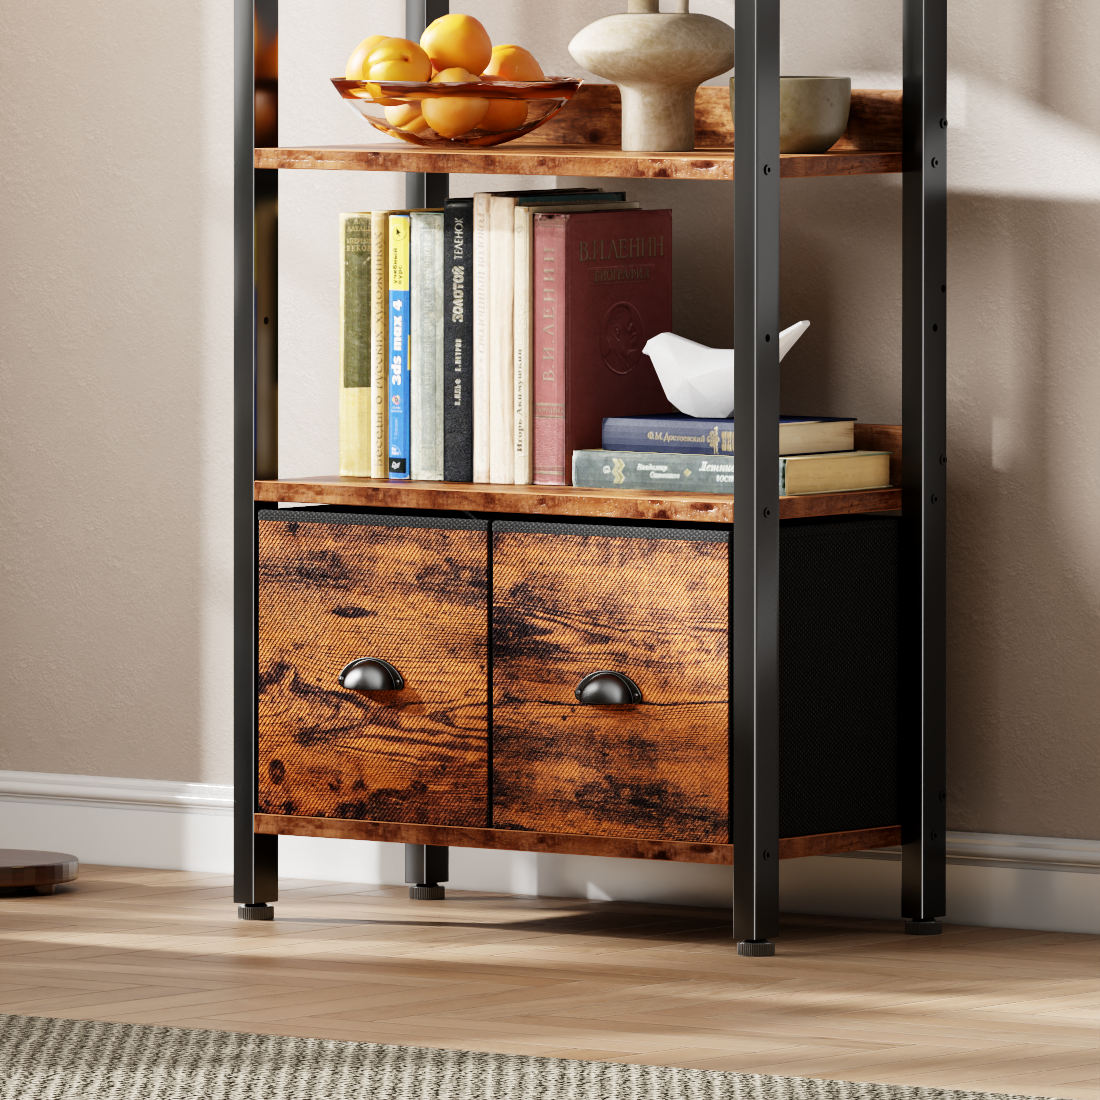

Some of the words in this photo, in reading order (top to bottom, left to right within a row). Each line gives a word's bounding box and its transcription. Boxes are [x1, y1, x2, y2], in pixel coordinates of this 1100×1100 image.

[453, 217, 464, 260] ТЕЛЕНОК
[593, 267, 650, 282] БИОГРАФИЯ
[393, 299, 402, 311] 4
[452, 266, 464, 322] ЗОЛОТОЙ
[393, 315, 402, 352] max
[391, 355, 402, 386] 3ds
[516, 348, 524, 416] Акимушкин
[516, 418, 524, 453] Игорь
[715, 474, 734, 483] гост
